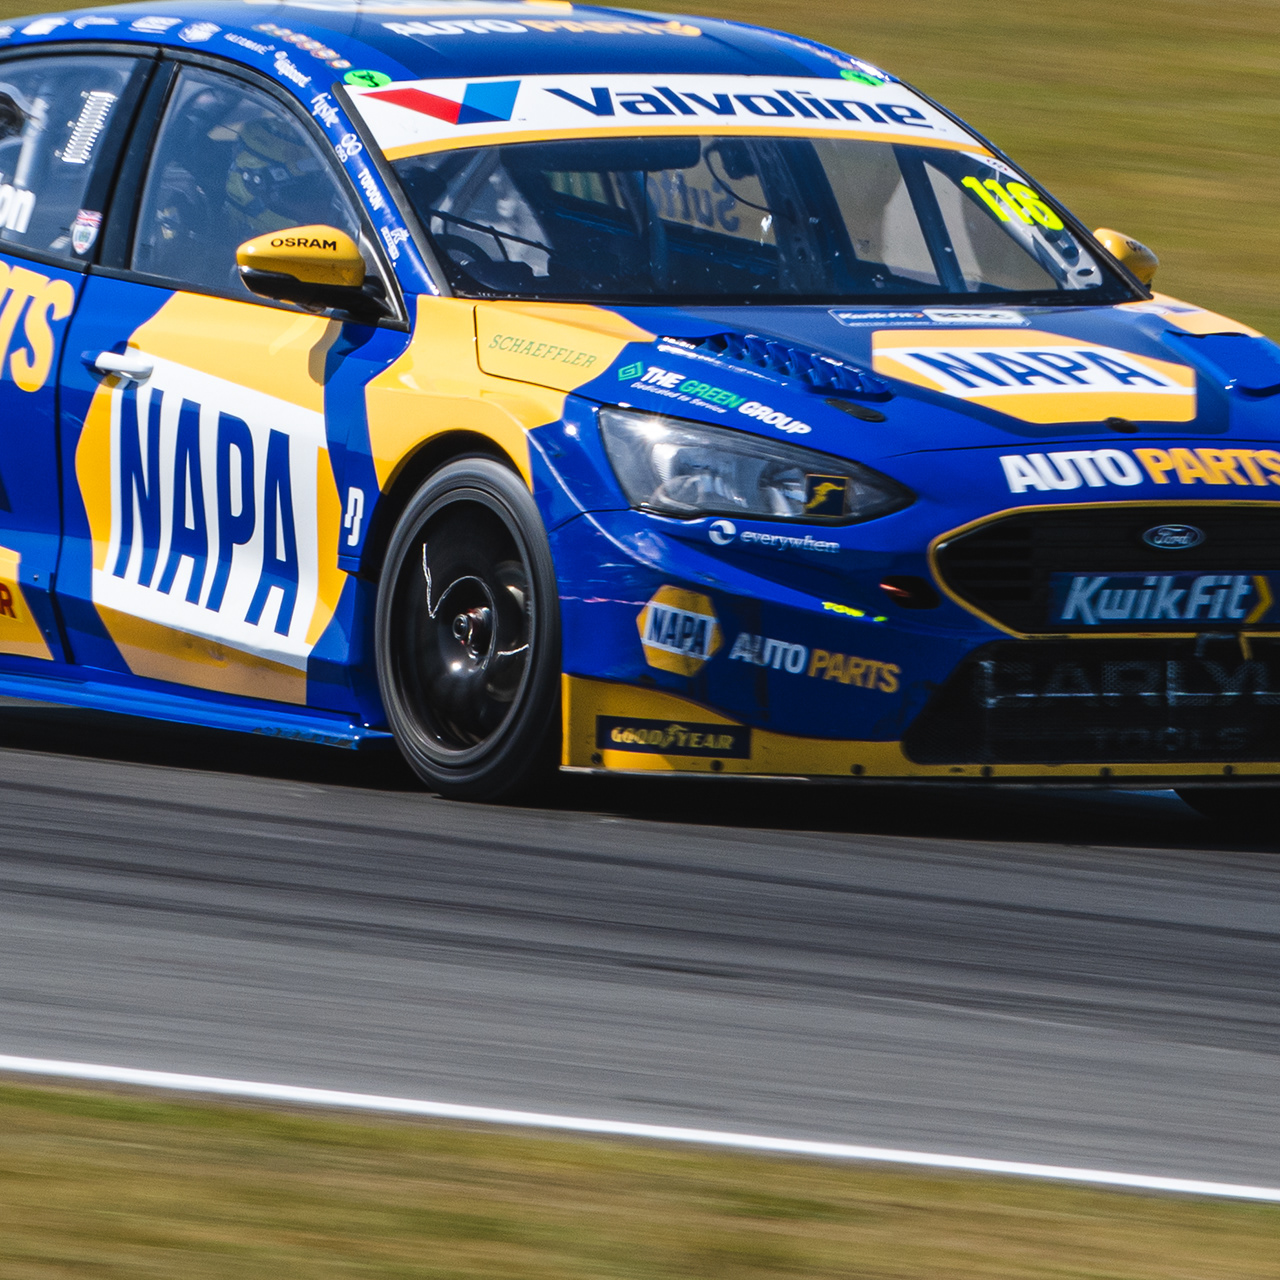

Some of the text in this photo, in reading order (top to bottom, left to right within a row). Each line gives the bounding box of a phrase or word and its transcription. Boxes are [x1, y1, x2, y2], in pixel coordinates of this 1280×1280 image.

[381, 19, 529, 36] AUTO
[542, 86, 934, 129] Valvoline
[961, 176, 1065, 231] 116
[271, 238, 337, 251] OSRAM
[488, 334, 597, 368] SCHAEFFLER
[904, 351, 1170, 389] NAPA
[640, 366, 812, 434] THE GREEN GROUP
[999, 449, 1145, 493] AUTO
[112, 380, 300, 638] NAPA
[740, 529, 840, 553] everywhen
[1153, 527, 1196, 546] Ford
[649, 604, 710, 655] NAPA
[729, 631, 902, 694] AUTO PARTS
